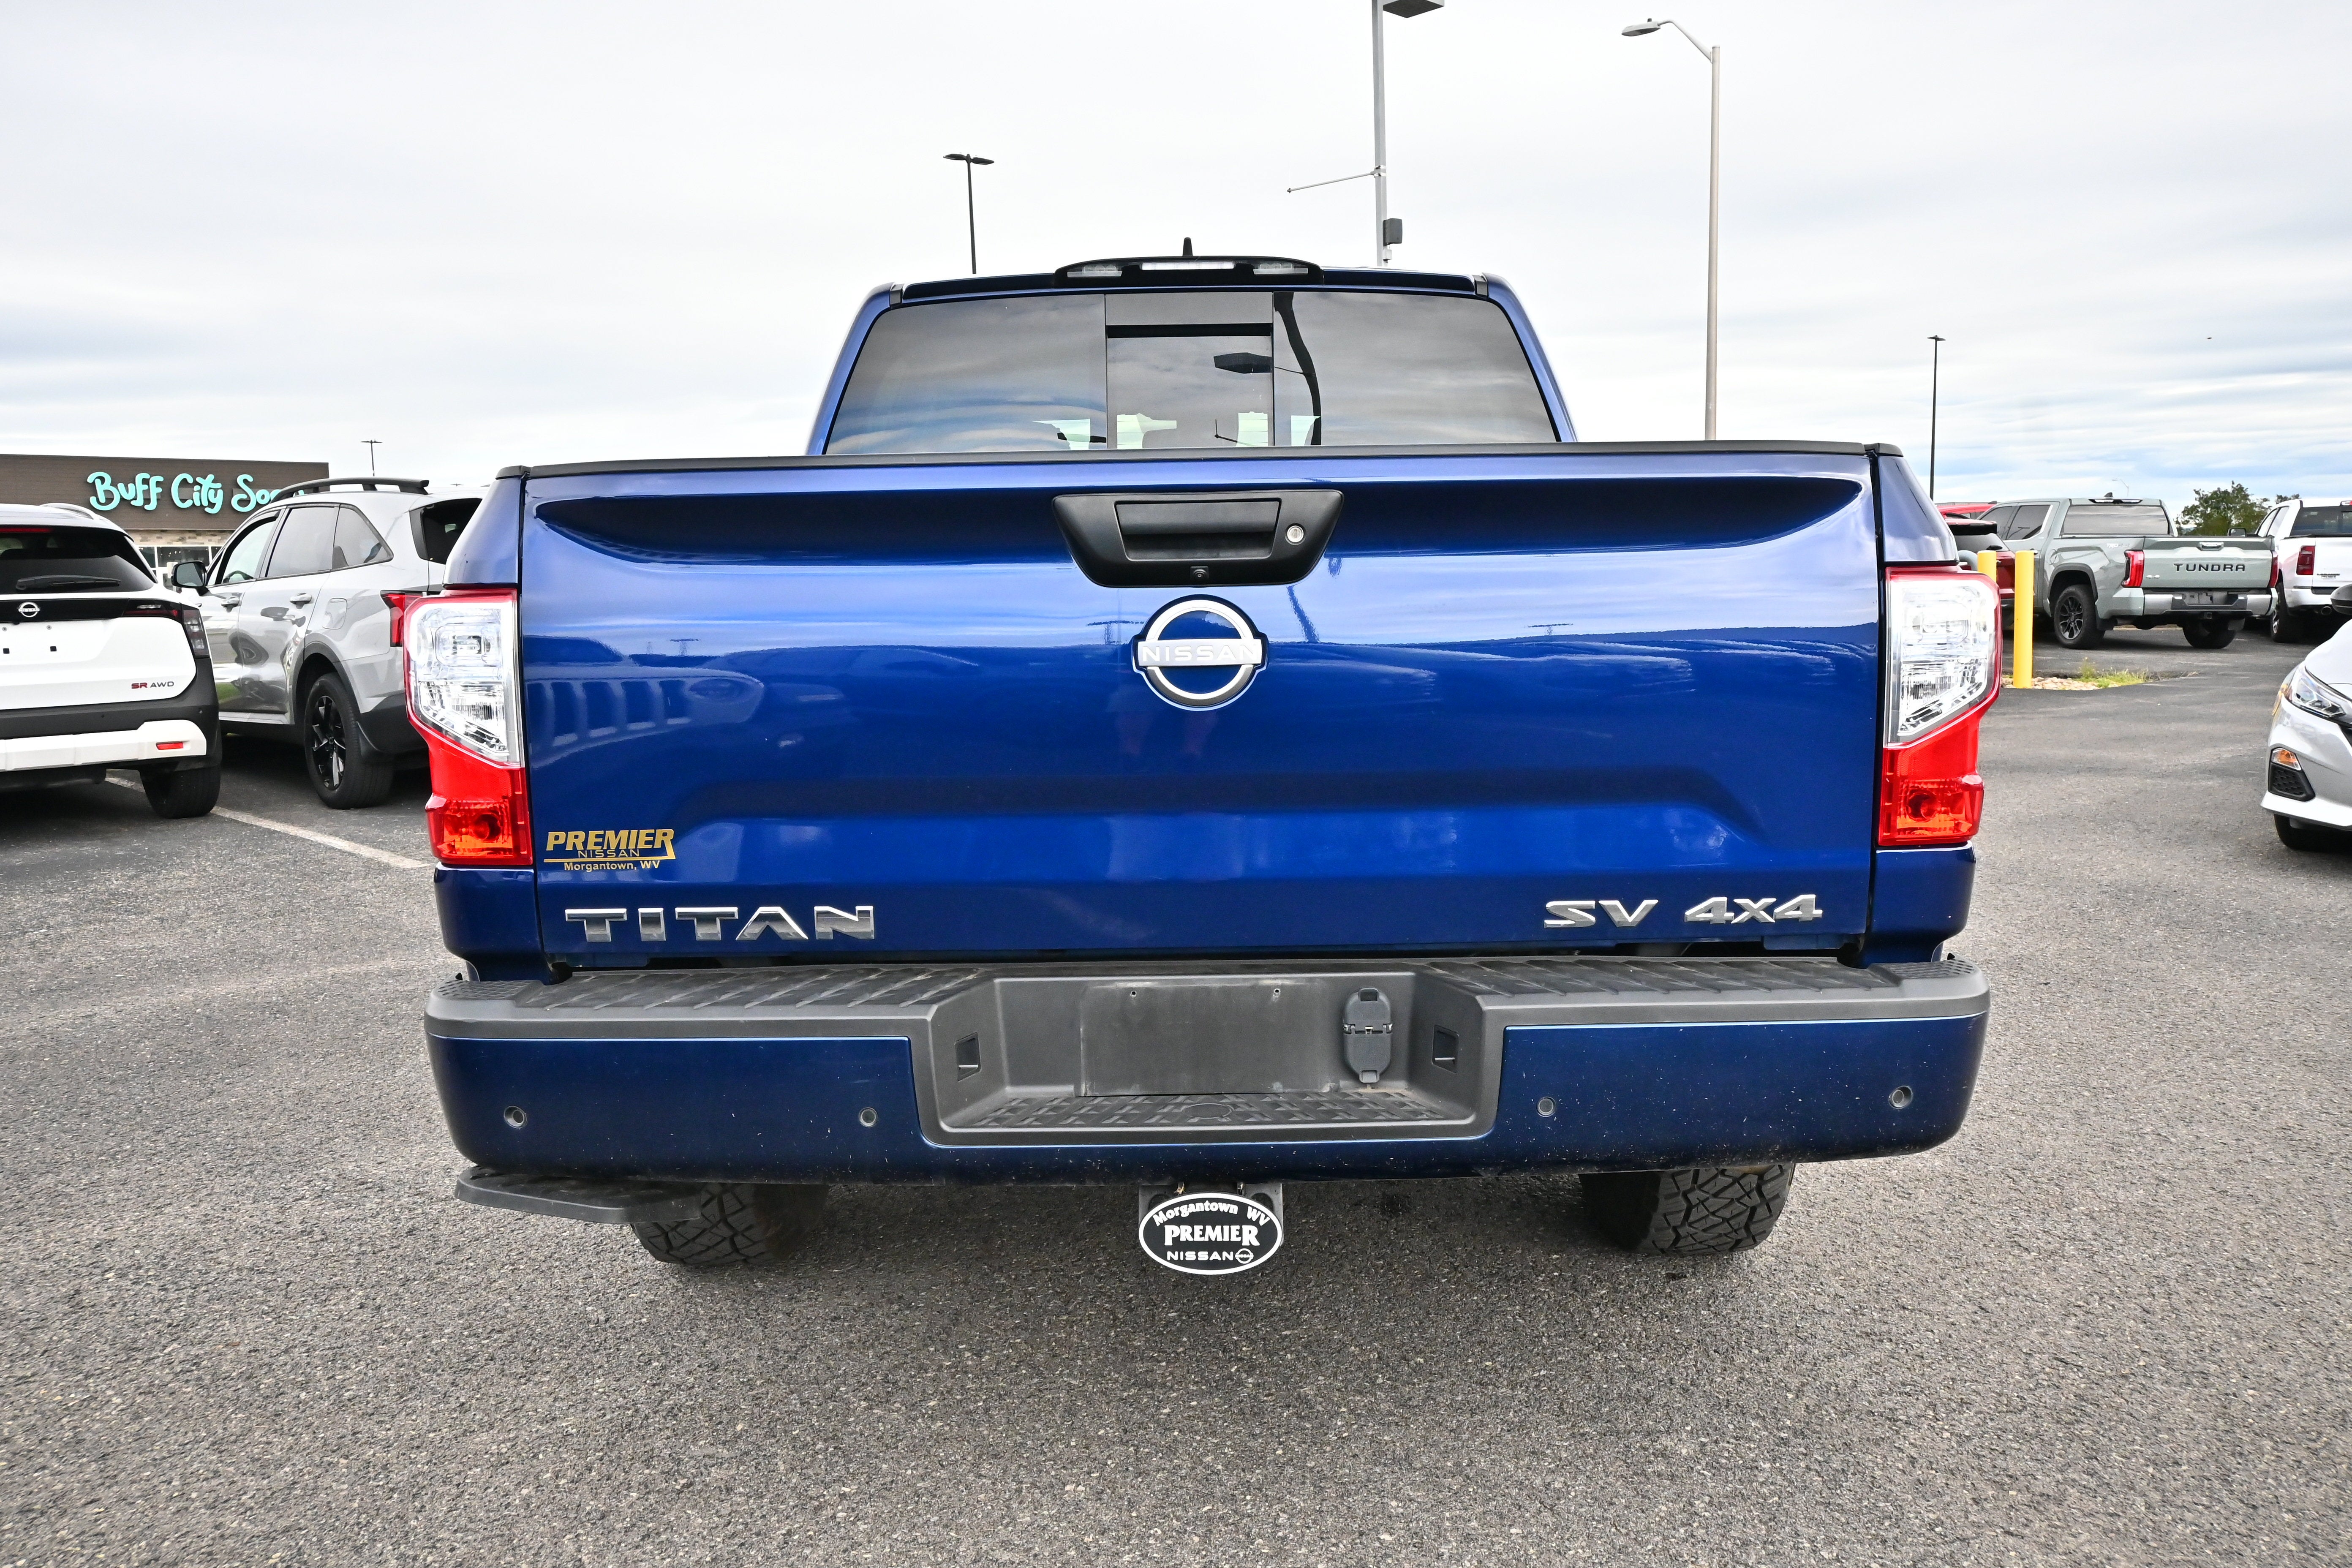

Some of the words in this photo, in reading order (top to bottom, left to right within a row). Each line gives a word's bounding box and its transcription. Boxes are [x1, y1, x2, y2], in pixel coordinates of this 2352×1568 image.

[87, 471, 164, 511] Buff
[171, 473, 224, 514] City
[231, 474, 305, 512] So
[2173, 564, 2245, 572] TUNDRA
[1142, 644, 1257, 662] NISSAN
[546, 829, 676, 859] PREMIER
[577, 849, 640, 858] NISSAN
[564, 862, 637, 872] Morgantown,
[640, 860, 660, 869] WV
[565, 906, 875, 942] TITAN
[1544, 899, 1659, 928] SV
[1152, 1200, 1238, 1226] Morgantown
[1247, 1206, 1270, 1226] WV
[1164, 1225, 1260, 1246] PREMIER
[1167, 1251, 1233, 1261] NISSAN
